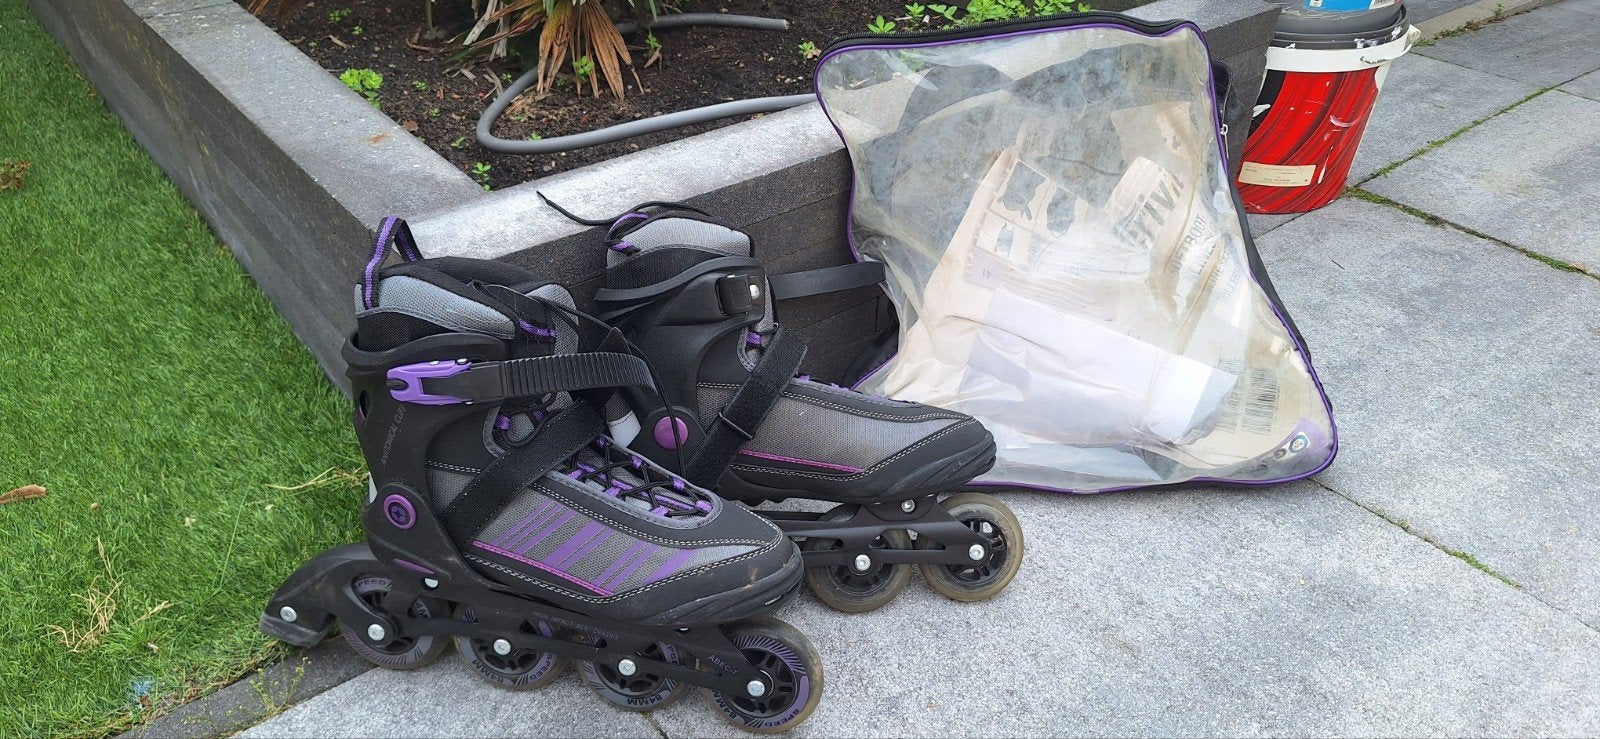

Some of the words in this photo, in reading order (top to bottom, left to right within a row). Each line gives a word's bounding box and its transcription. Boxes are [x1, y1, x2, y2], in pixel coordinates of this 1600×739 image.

[707, 654, 738, 675] ABEC-7
[626, 694, 664, 706] 84MM
[712, 689, 738, 719] 84MM
[764, 708, 801, 727] SPEED
